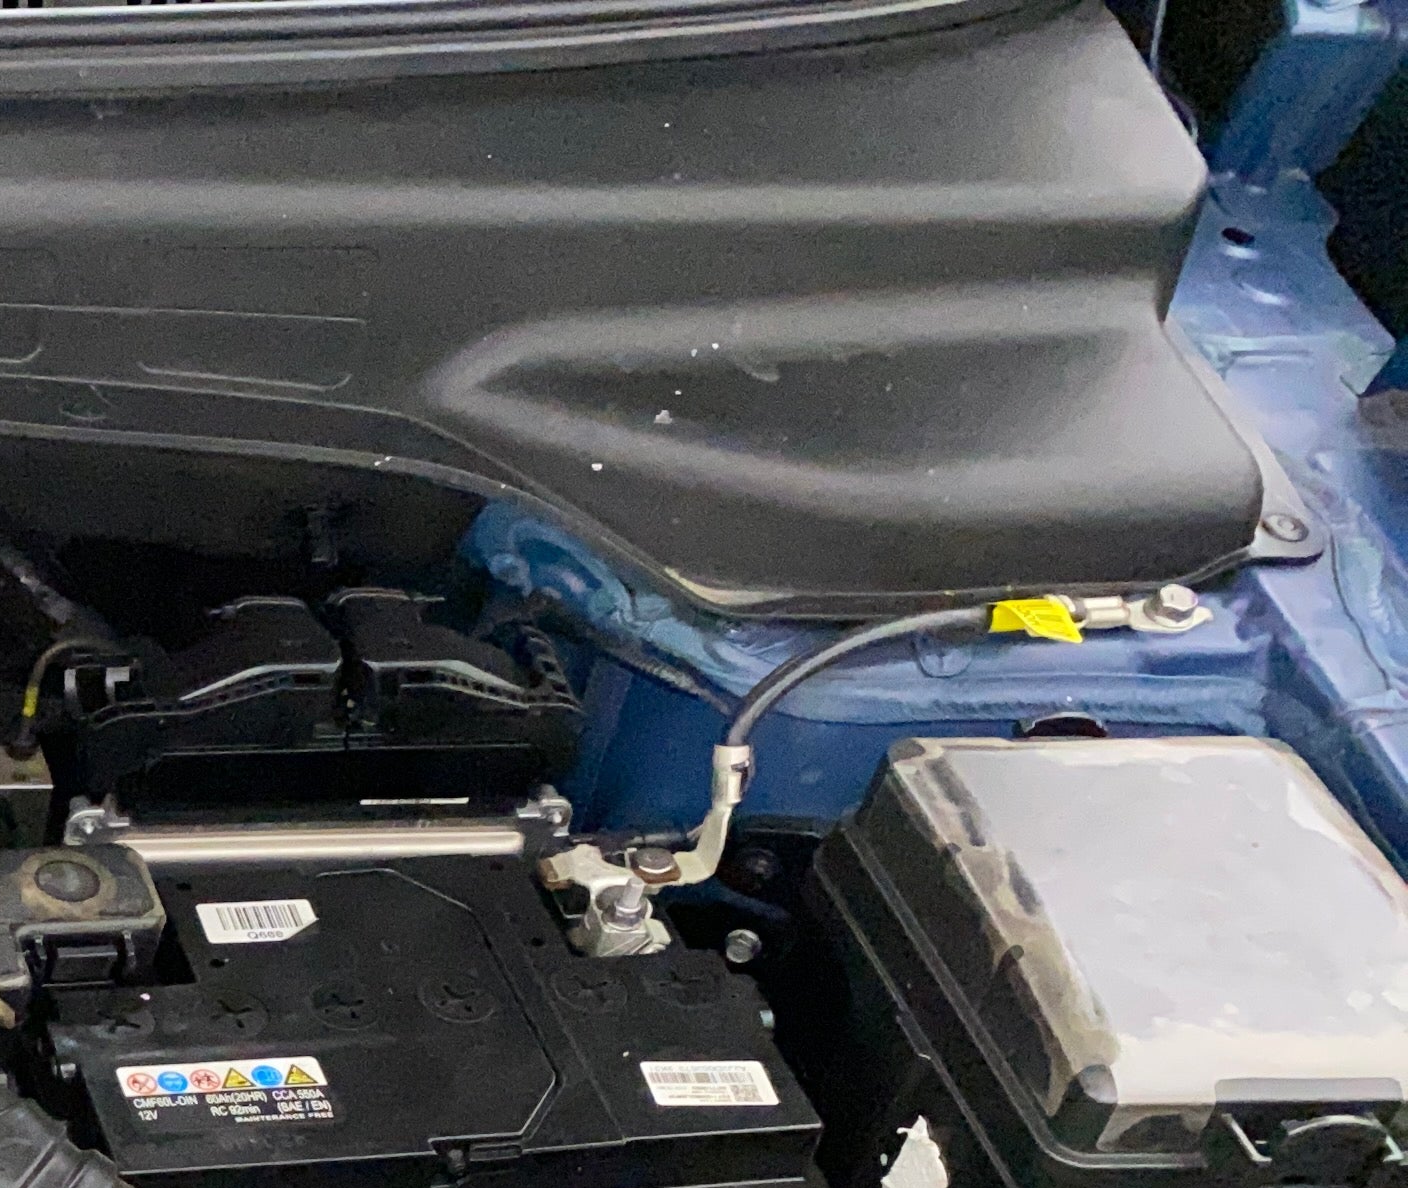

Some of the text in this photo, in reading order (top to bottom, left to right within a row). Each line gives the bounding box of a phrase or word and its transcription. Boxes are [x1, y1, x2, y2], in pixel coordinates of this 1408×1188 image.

[271, 1089, 298, 1100] CCA
[137, 1109, 159, 1121] 12V
[209, 1106, 229, 1117] RC
